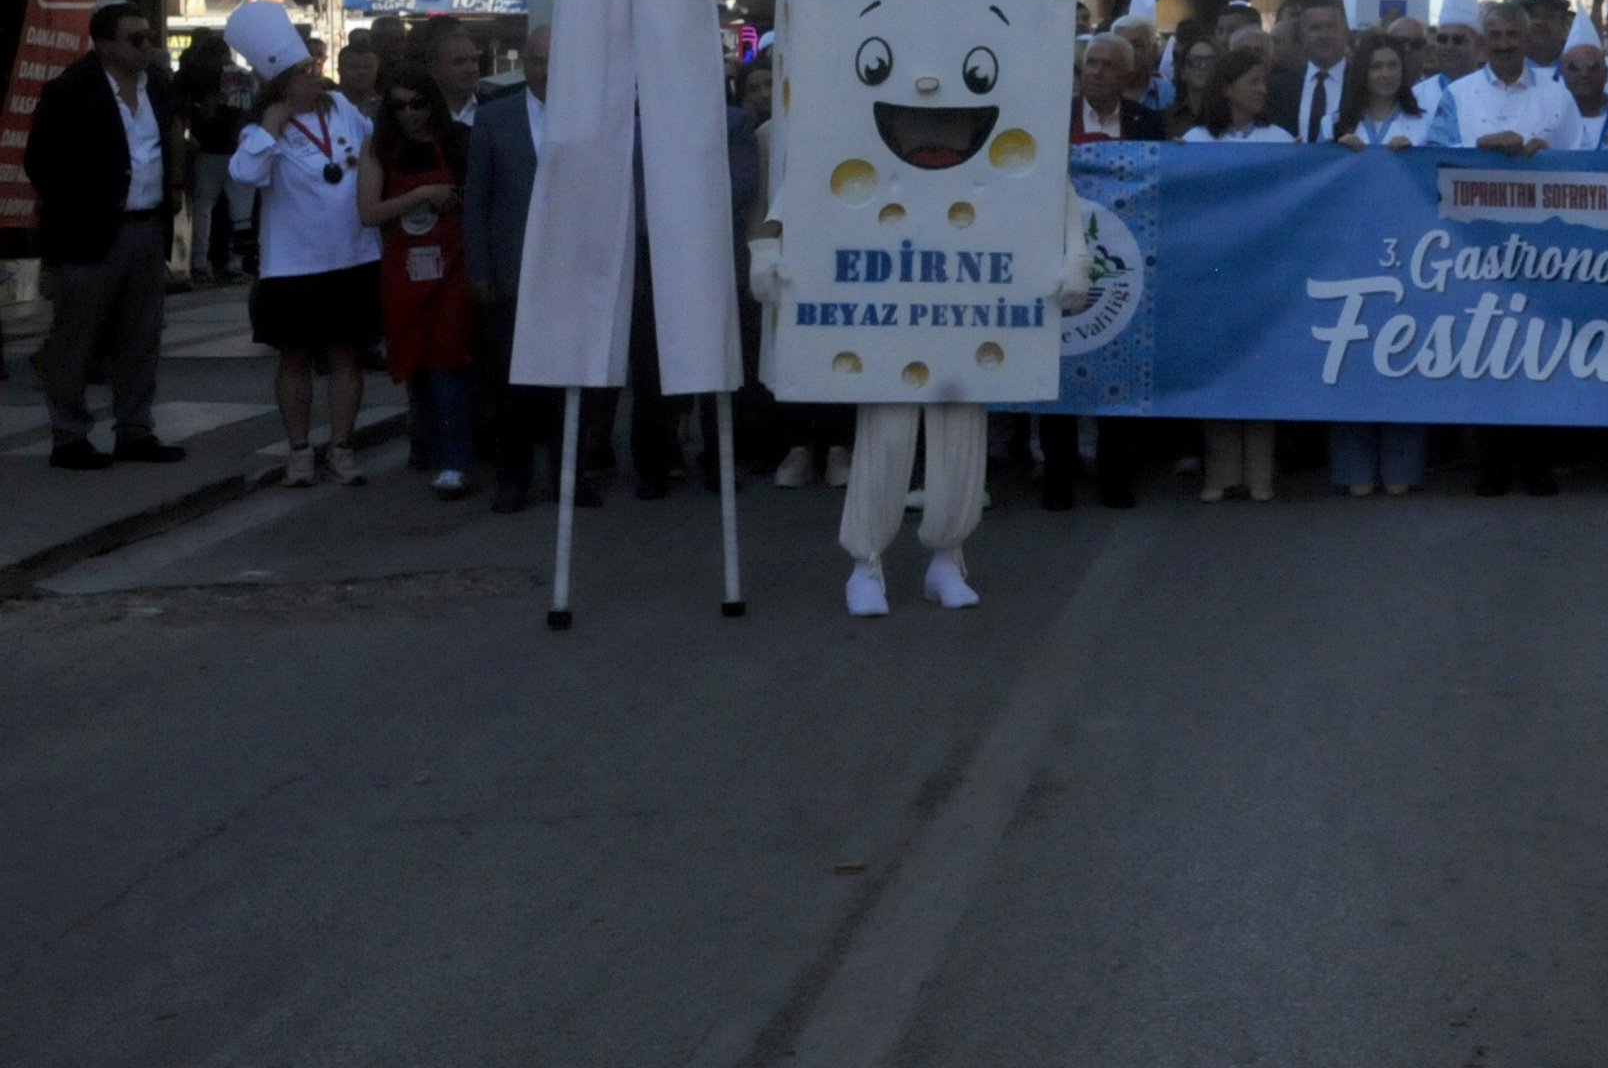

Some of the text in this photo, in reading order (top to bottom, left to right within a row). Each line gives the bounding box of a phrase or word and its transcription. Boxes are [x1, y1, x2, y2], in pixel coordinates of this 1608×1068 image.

[1453, 180, 1537, 209] TOPRAKTAN
[1542, 183, 1608, 211] SOFRAYA
[834, 239, 1014, 284] EDİRNE
[1379, 238, 1402, 268] 3.
[796, 297, 1045, 327] BEYAZ PEYNİRİ
